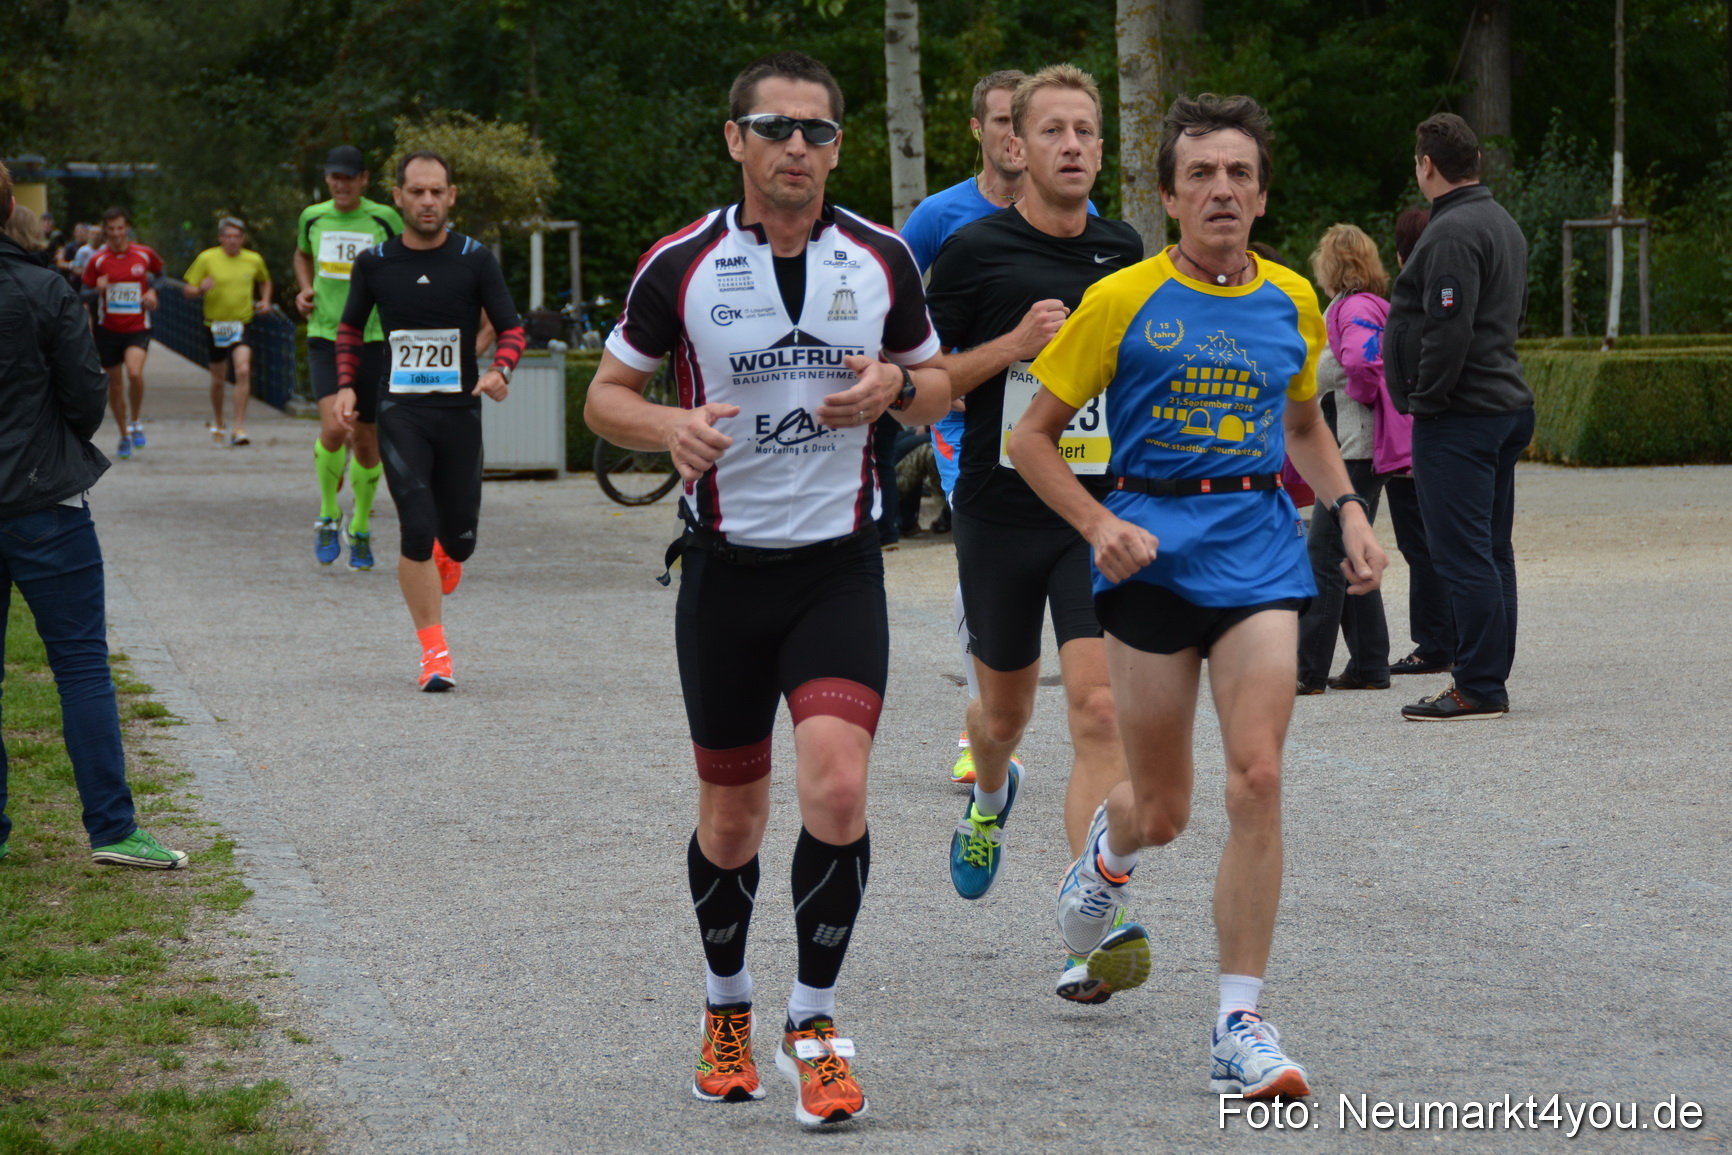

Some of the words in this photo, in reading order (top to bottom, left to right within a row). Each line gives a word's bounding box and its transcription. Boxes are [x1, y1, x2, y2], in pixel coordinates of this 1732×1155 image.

[336, 243, 356, 261] 18
[715, 256, 749, 269] FRANK
[1159, 322, 1170, 330] 15
[1153, 331, 1177, 339] Jahre
[399, 344, 453, 368] 2720
[410, 373, 440, 384] Tobias
[732, 370, 857, 385] BAUUNTERNEHME
[755, 445, 800, 456] Marketing
[803, 444, 809, 454] &
[811, 442, 836, 453] Druck
